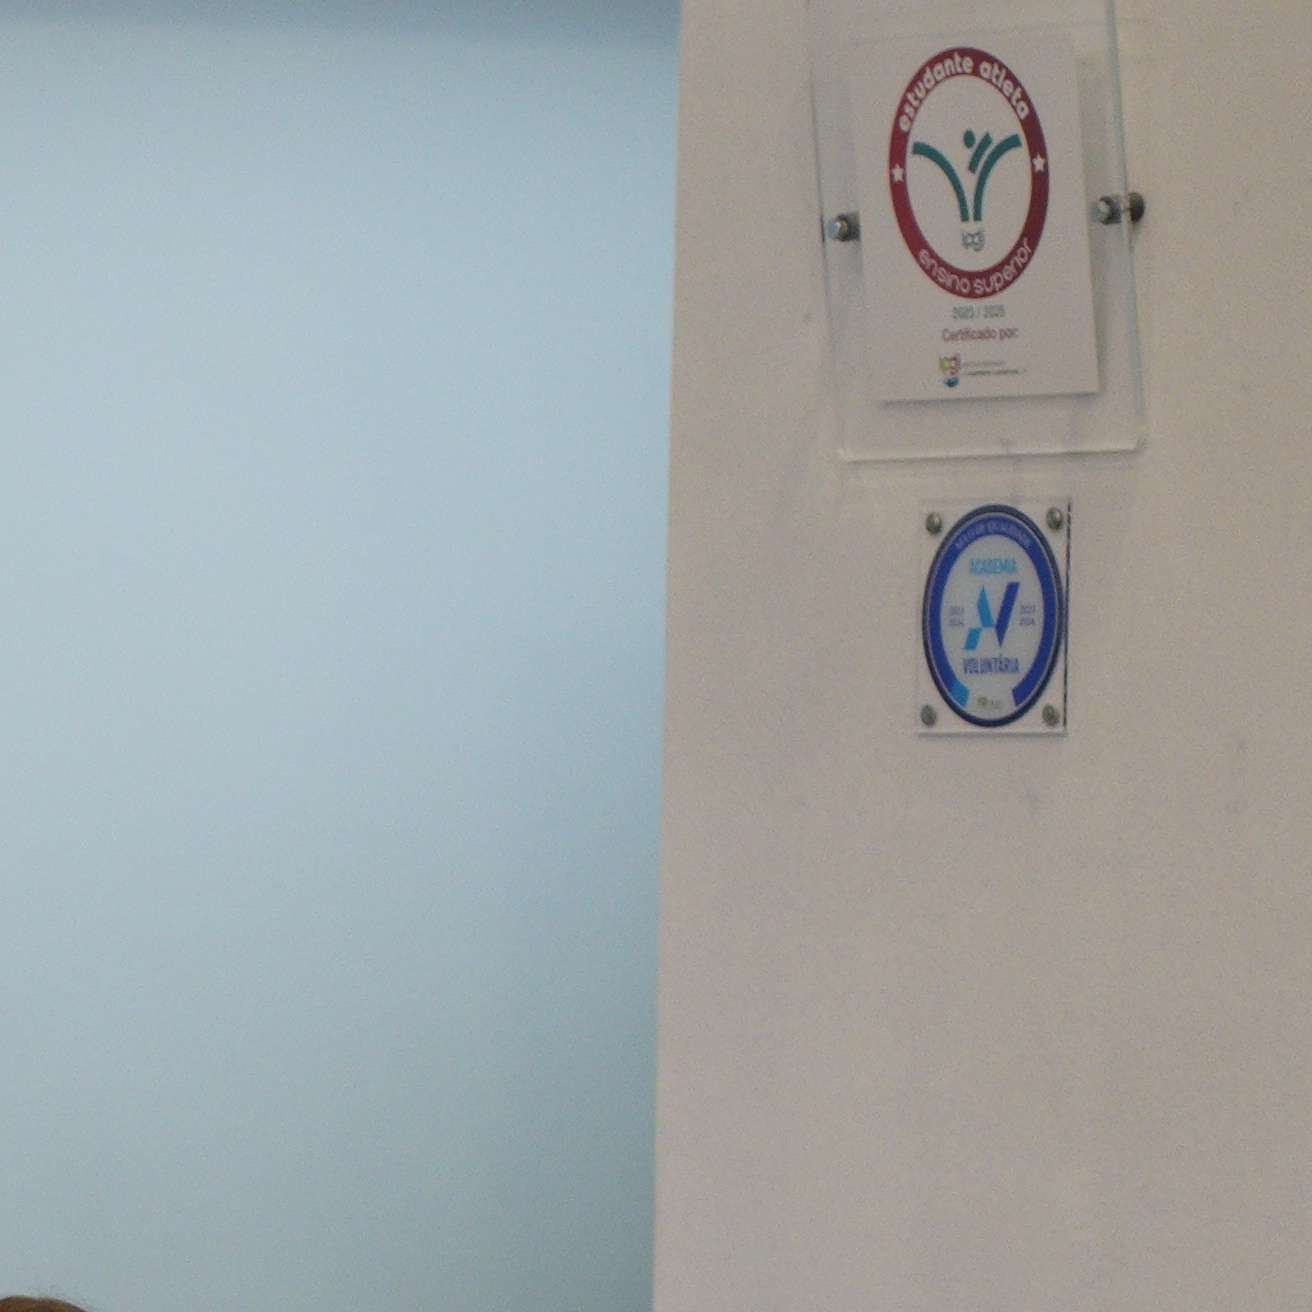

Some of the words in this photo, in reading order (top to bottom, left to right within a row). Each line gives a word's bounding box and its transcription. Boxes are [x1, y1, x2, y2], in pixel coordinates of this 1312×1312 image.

[898, 51, 974, 133] estudante
[979, 60, 1030, 121] atleta
[918, 249, 971, 293] ensino
[974, 237, 1032, 295] superior
[941, 327, 997, 342] Certificado
